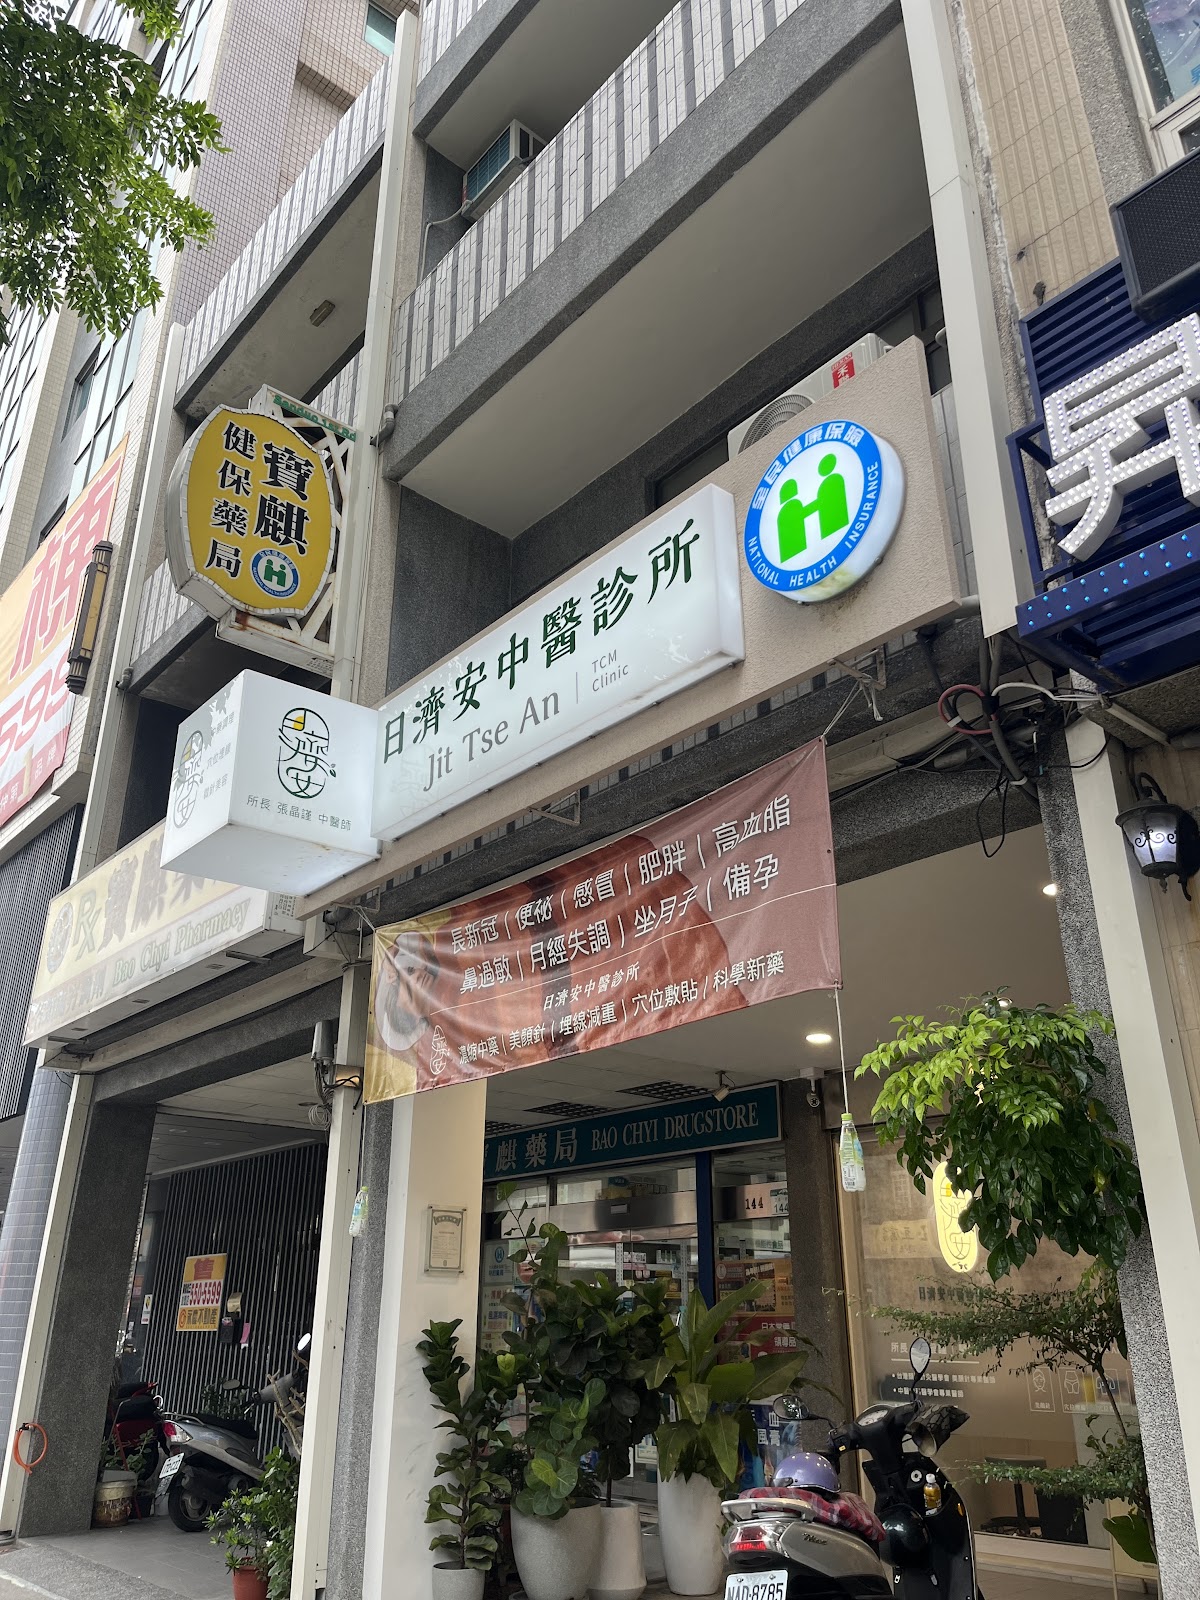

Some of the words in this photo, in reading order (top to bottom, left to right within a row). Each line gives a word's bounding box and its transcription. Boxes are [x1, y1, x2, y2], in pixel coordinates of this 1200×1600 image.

[205, 421, 257, 578] 健保藥局
[254, 442, 315, 555] 寶麒
[752, 422, 865, 510] 全民健康保險
[748, 536, 779, 586] NATIONAL
[789, 556, 837, 587] HEALTH
[845, 461, 878, 549] INSURANCE
[384, 518, 700, 764] 日濟安中醫診所
[591, 649, 618, 674] TCM
[592, 663, 629, 692] Clinic
[423, 745, 453, 792] Jit
[462, 719, 509, 764] Tse
[519, 691, 560, 734] An
[246, 794, 271, 811] 所長
[318, 813, 351, 831] 中醫師
[450, 914, 499, 955] 長新冠
[573, 868, 615, 909] 感冒
[638, 840, 687, 886] 肥胖
[712, 793, 792, 858] 高血脂
[113, 962, 136, 987] Bao
[140, 931, 170, 973] Chyi
[174, 896, 252, 954] Pharmacy
[459, 954, 513, 996] 鼻過敏
[530, 922, 611, 975] 月經失調
[634, 884, 698, 939] 坐月子
[723, 853, 780, 902] 備孕
[459, 1036, 500, 1066] 濃縮中藥
[509, 1023, 546, 1051] 美顏針
[558, 1000, 618, 1038] 埋線減重
[632, 978, 699, 1018] 穴位敷貼
[713, 950, 786, 993] 科學新藥
[543, 961, 640, 1013] 日濟安中醫診所
[484, 1126, 578, 1172] 麒藥局
[591, 1125, 618, 1151] BAO
[622, 1119, 658, 1147] CHYI
[665, 1101, 759, 1141] DRUGSTORE
[745, 1196, 764, 1210] 144
[189, 1281, 222, 1306] 550-5599
[194, 1258, 215, 1281] 售
[891, 1342, 908, 1354] 所長
